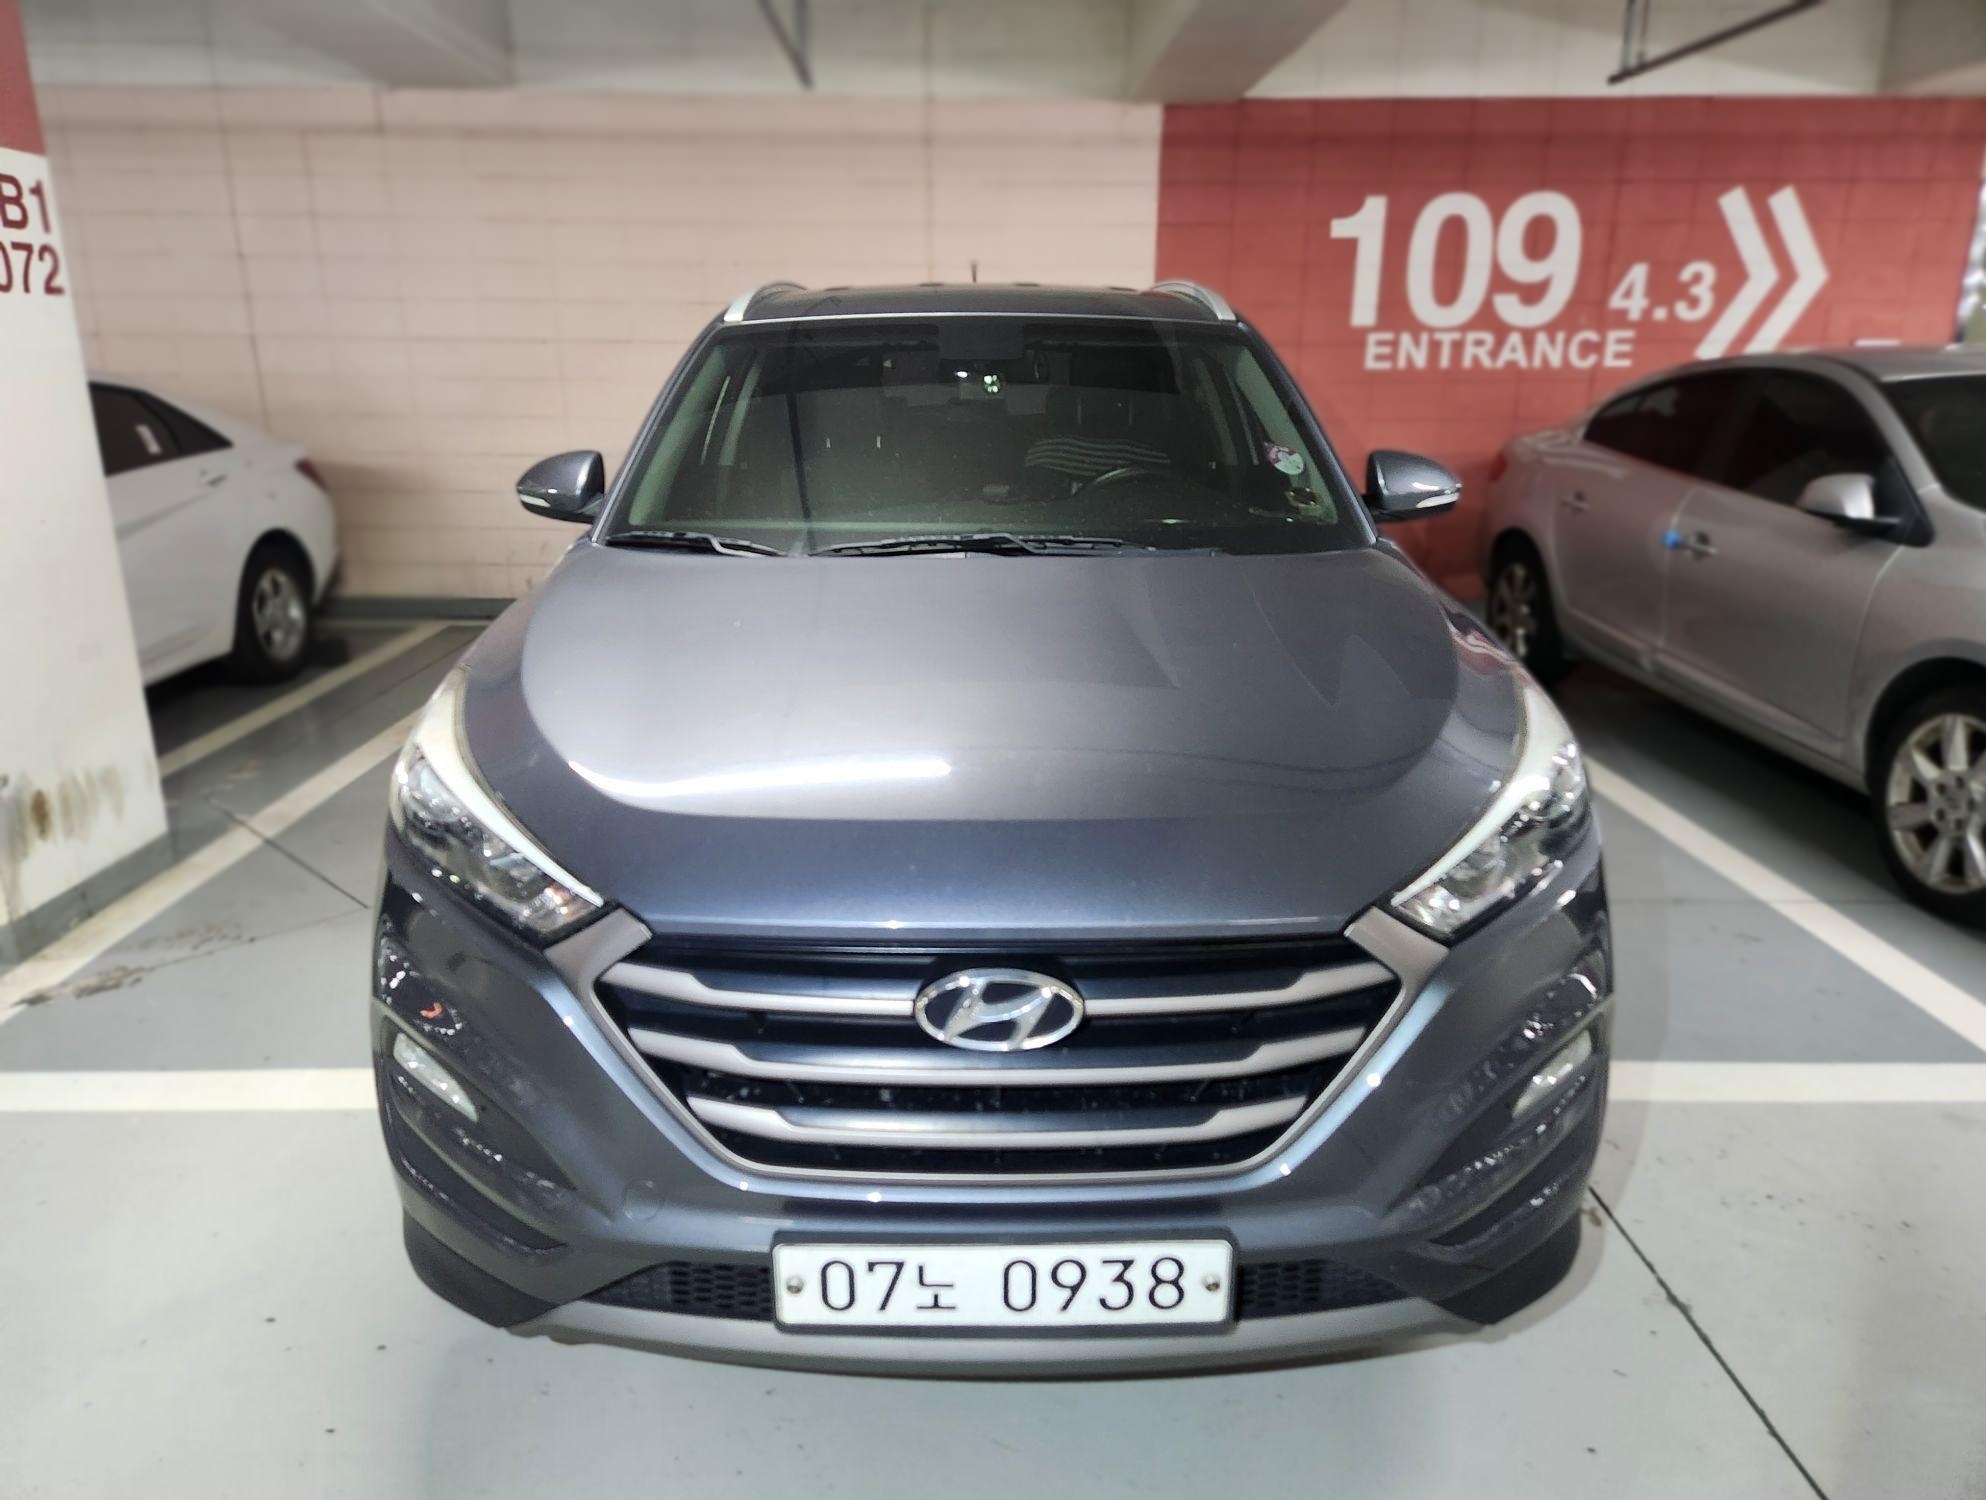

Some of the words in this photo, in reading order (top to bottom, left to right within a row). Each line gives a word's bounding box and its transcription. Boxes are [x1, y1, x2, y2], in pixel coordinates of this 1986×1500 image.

[0, 173, 51, 234] B1
[1330, 191, 1582, 328] 109
[1608, 261, 1717, 322] 4.3
[1364, 330, 1636, 371] ENTRANCE
[820, 1260, 957, 1312] 07노
[1002, 1257, 1186, 1312] 0938
